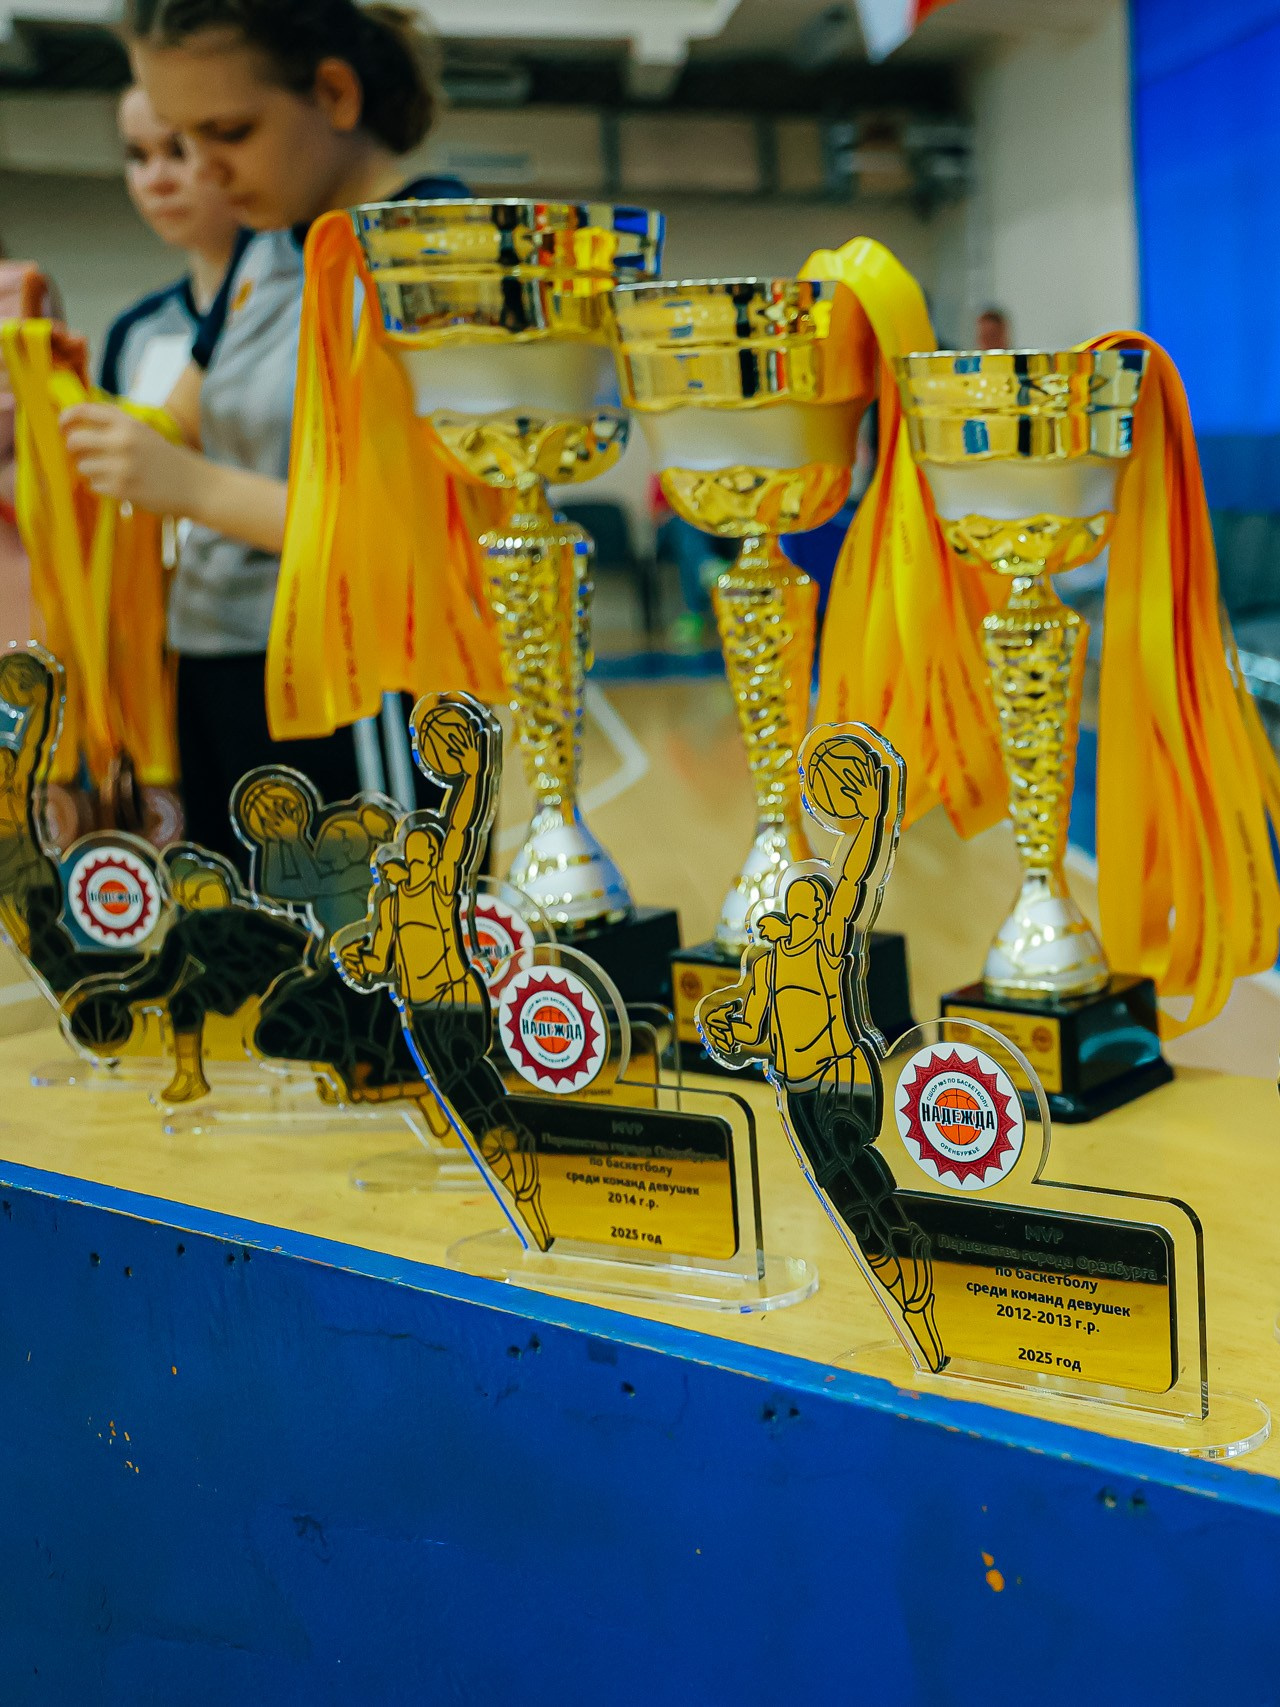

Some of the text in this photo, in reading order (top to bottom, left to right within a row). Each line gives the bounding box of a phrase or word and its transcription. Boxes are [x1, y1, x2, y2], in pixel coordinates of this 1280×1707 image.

[921, 1103, 995, 1130] НАДЕЖДА
[941, 1142, 980, 1156] ОРЕНБУРЖЬЕ
[606, 1156, 673, 1177] баскетболу
[566, 1171, 699, 1196] среди команд девушек
[608, 1192, 659, 1210] 2014 г.р.
[611, 1227, 662, 1245] 2025 год
[1024, 1225, 1064, 1244] MVP
[996, 1266, 1098, 1294] по баскетболу
[1076, 1256, 1158, 1281] Оренбурга
[966, 1282, 1130, 1317] среди команд девушек
[996, 1304, 1100, 1334] 2012-2013 г.р.
[1018, 1347, 1082, 1372] 2025 год
